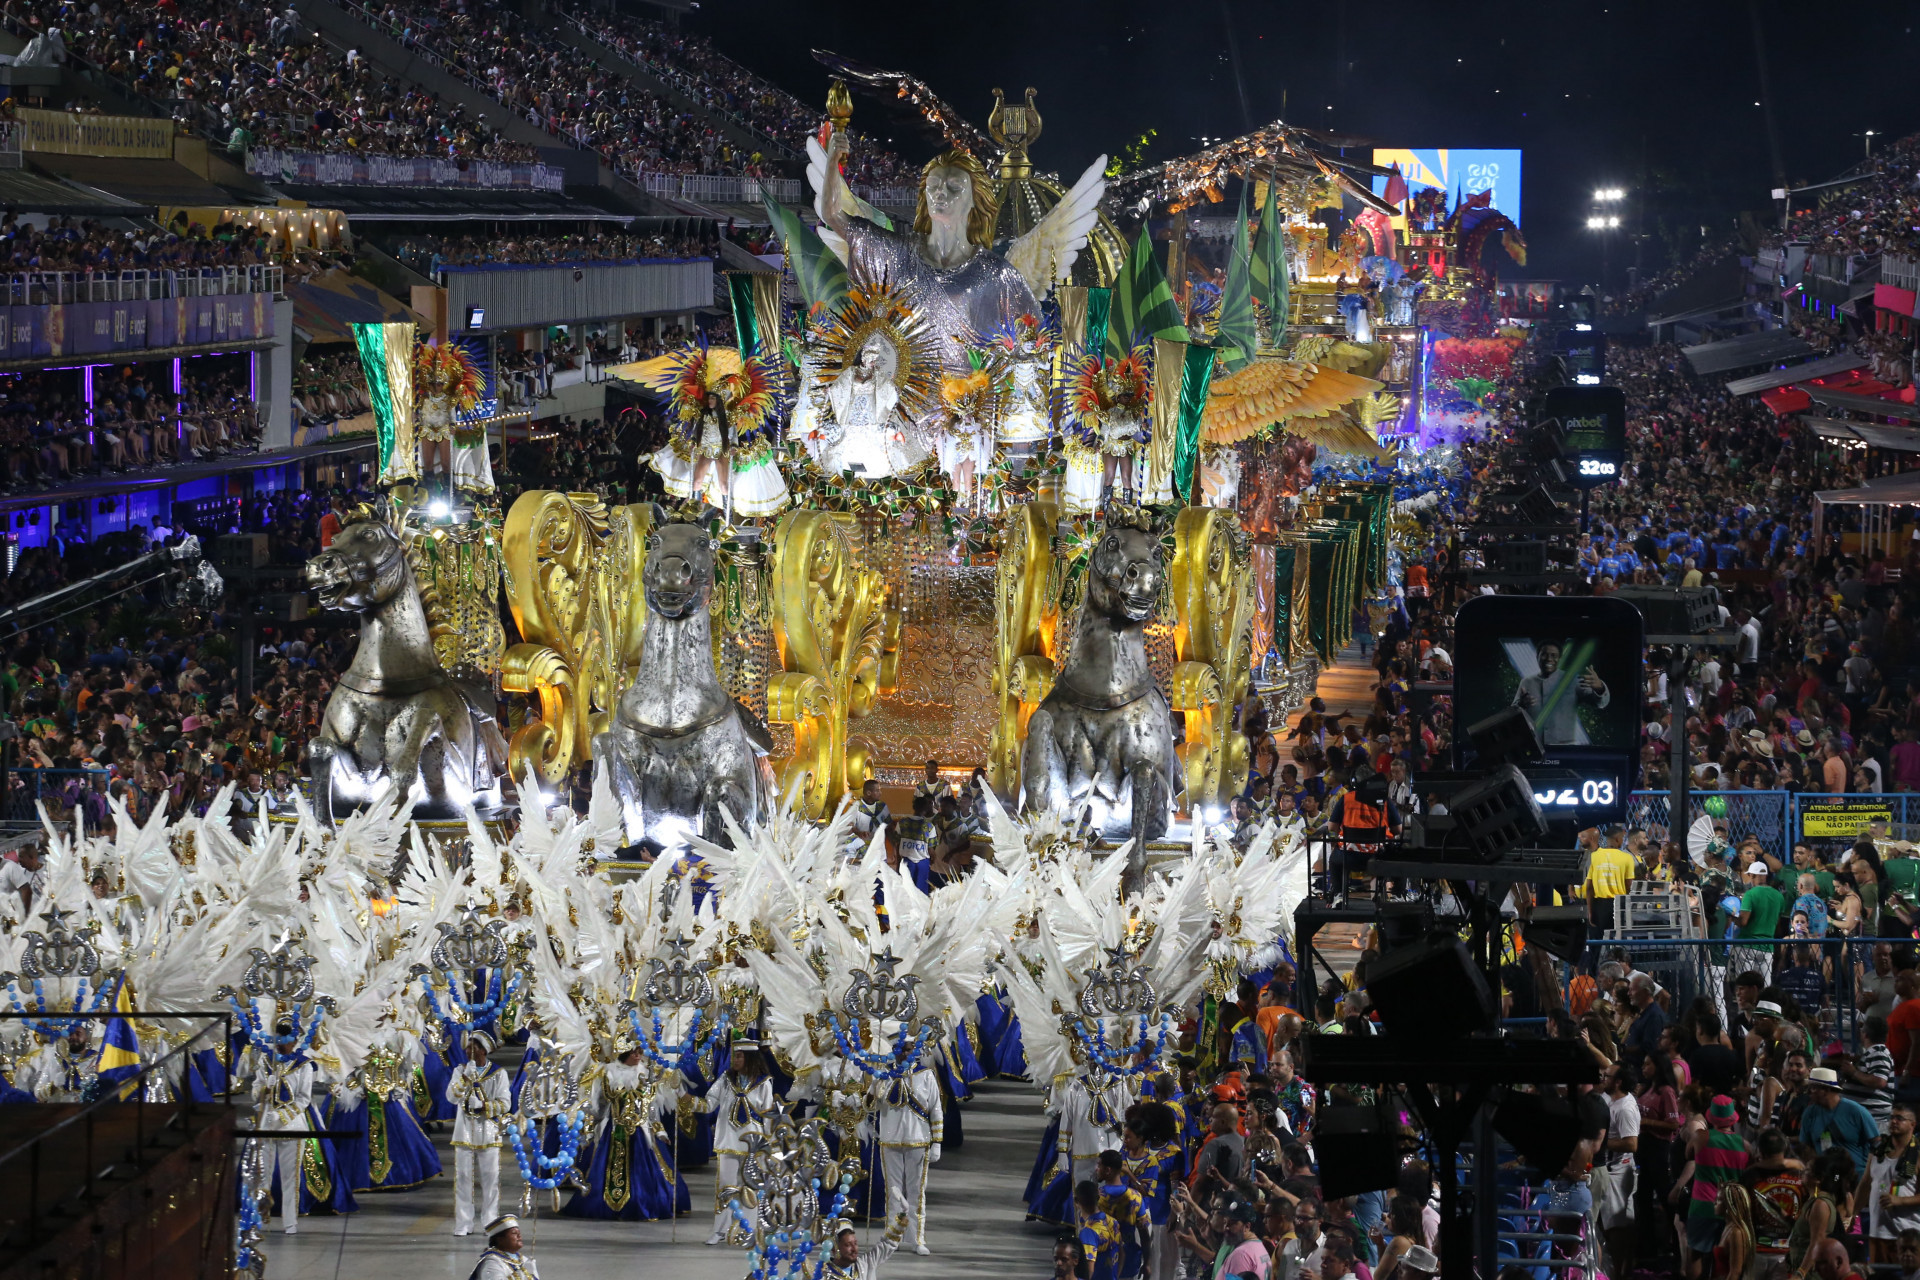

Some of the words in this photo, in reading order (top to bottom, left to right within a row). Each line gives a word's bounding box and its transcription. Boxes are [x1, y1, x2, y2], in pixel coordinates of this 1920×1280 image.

[31, 120, 55, 142] FOLIA
[58, 124, 80, 145] MAIS
[82, 125, 120, 147] TROPICAL
[123, 128, 134, 148] DA
[17, 321, 32, 343] VOCÊ
[134, 315, 146, 335] VOCÊ
[1580, 460, 1600, 474] 32
[1600, 463, 1615, 474] 03
[1582, 781, 1614, 804] 03
[1809, 804, 1844, 812] ATENÇÃO!
[1805, 813, 1826, 822] ÁREA
[1838, 813, 1890, 822] CIRCULAO
[1826, 821, 1843, 829] NÃO
